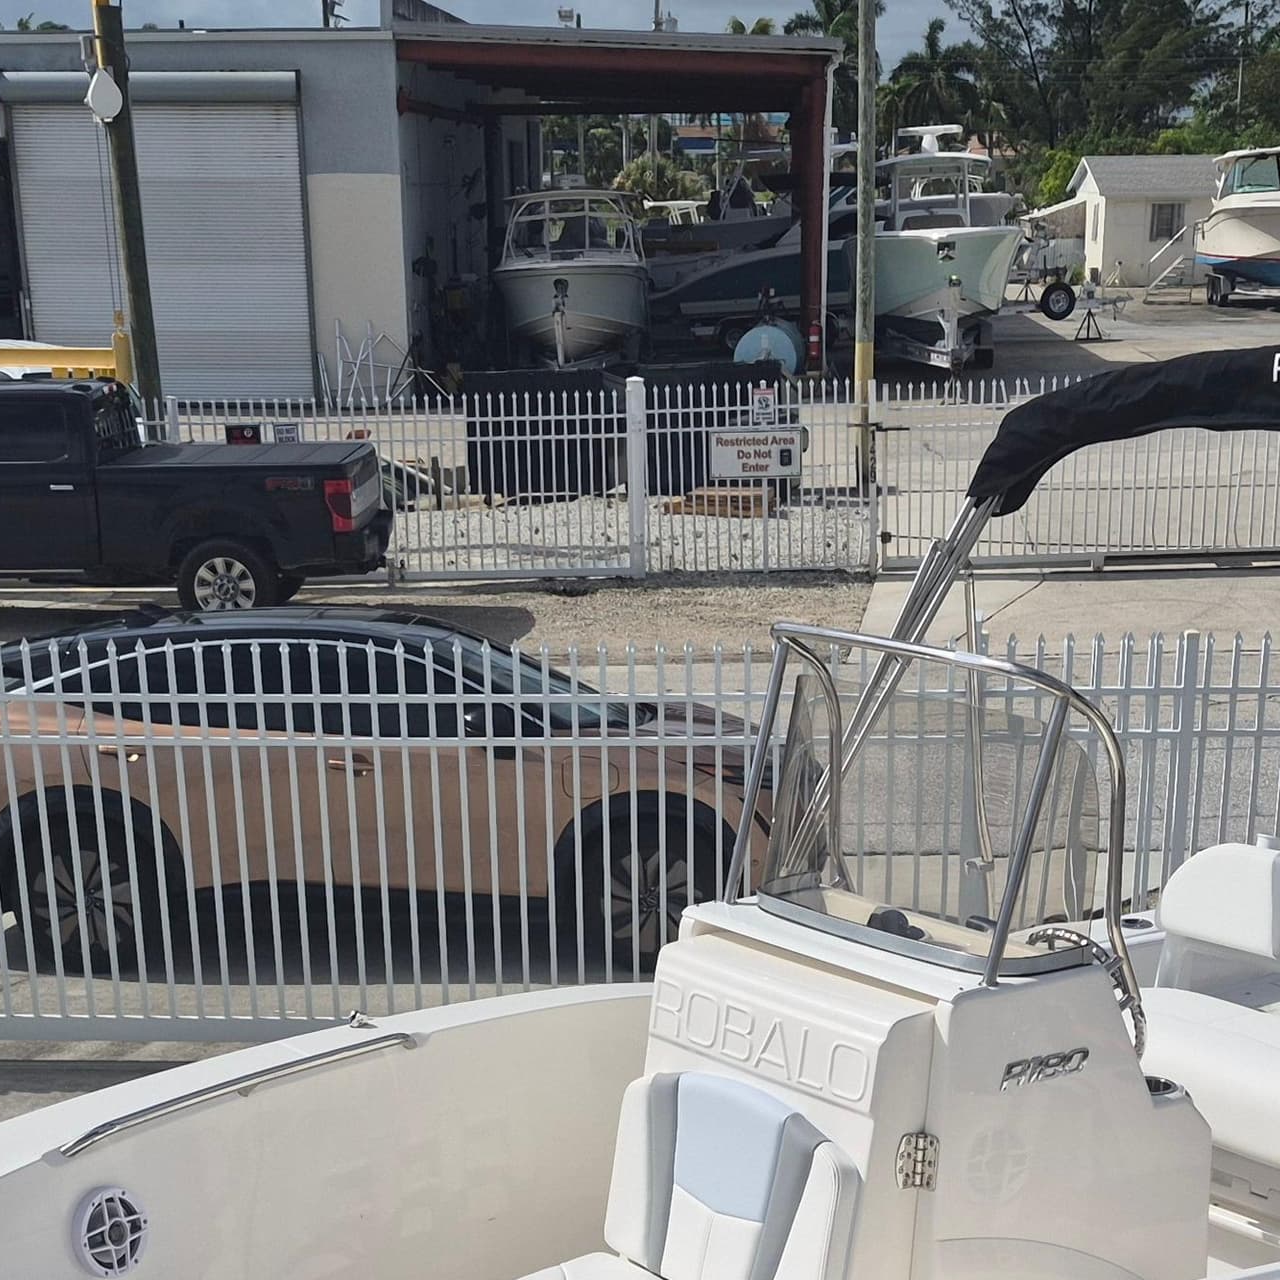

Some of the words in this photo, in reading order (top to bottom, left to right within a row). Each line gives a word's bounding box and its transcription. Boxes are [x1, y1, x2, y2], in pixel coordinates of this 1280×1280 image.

[716, 436, 769, 447] Restricted
[770, 436, 795, 446] Area
[737, 450, 752, 459] Do
[753, 449, 772, 459] Not
[742, 463, 769, 473] Enter
[651, 978, 871, 1102] ROBALO
[999, 1047, 1090, 1092] R180
